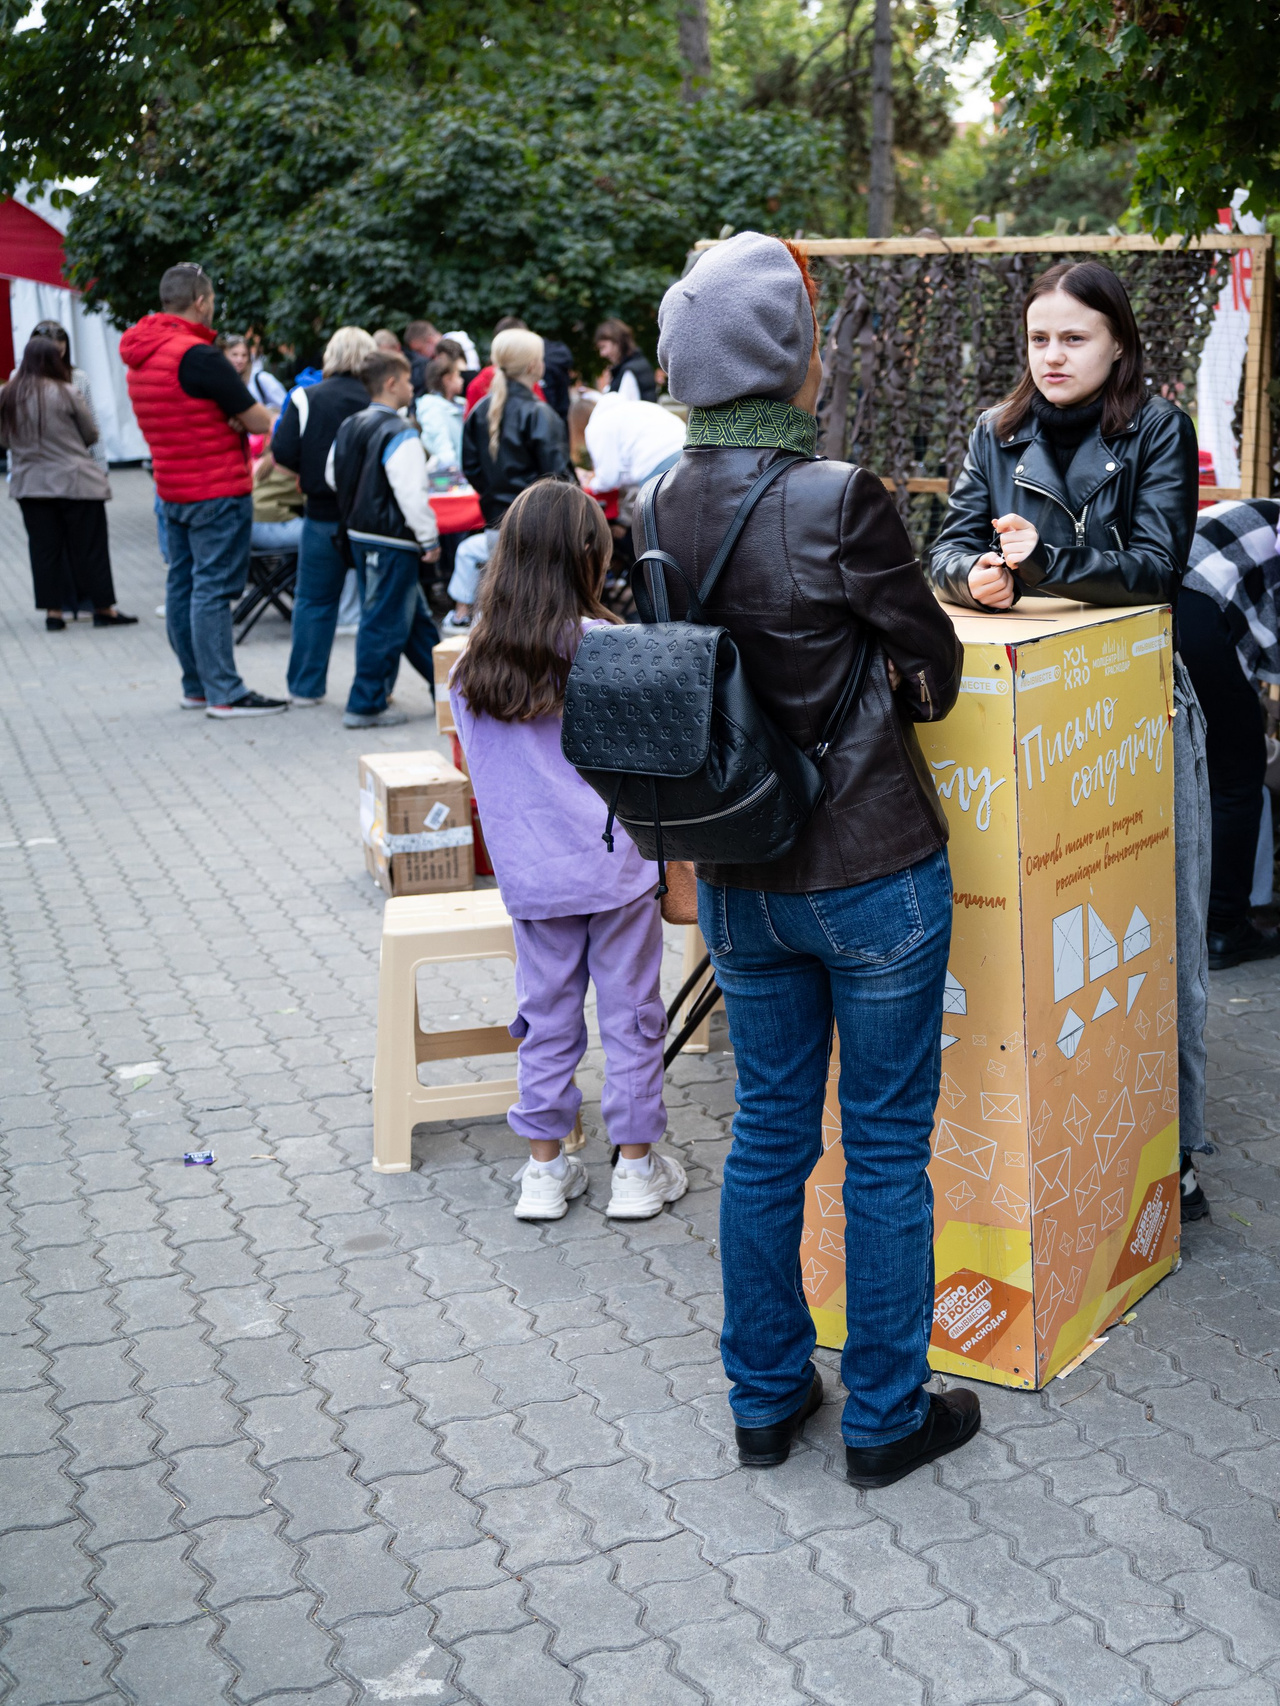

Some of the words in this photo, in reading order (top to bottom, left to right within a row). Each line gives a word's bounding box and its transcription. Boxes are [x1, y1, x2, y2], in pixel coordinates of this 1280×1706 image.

[960, 680, 991, 691] МЕСТЕ
[1104, 660, 1130, 676] КРАСНОДАР
[1020, 697, 1118, 790] Письмо
[1071, 715, 1168, 807] солдату
[1026, 832, 1063, 876] Отправь
[1065, 834, 1095, 855] письмо
[1096, 825, 1110, 841] или
[1112, 809, 1143, 837] рисунок
[1055, 859, 1101, 896] российским
[940, 1317, 949, 1328] В
[947, 1281, 990, 1321] РОССИИ
[950, 1301, 990, 1337] #МЫВМЕСТЕ
[960, 1309, 1007, 1353] КРАСНОДАР
